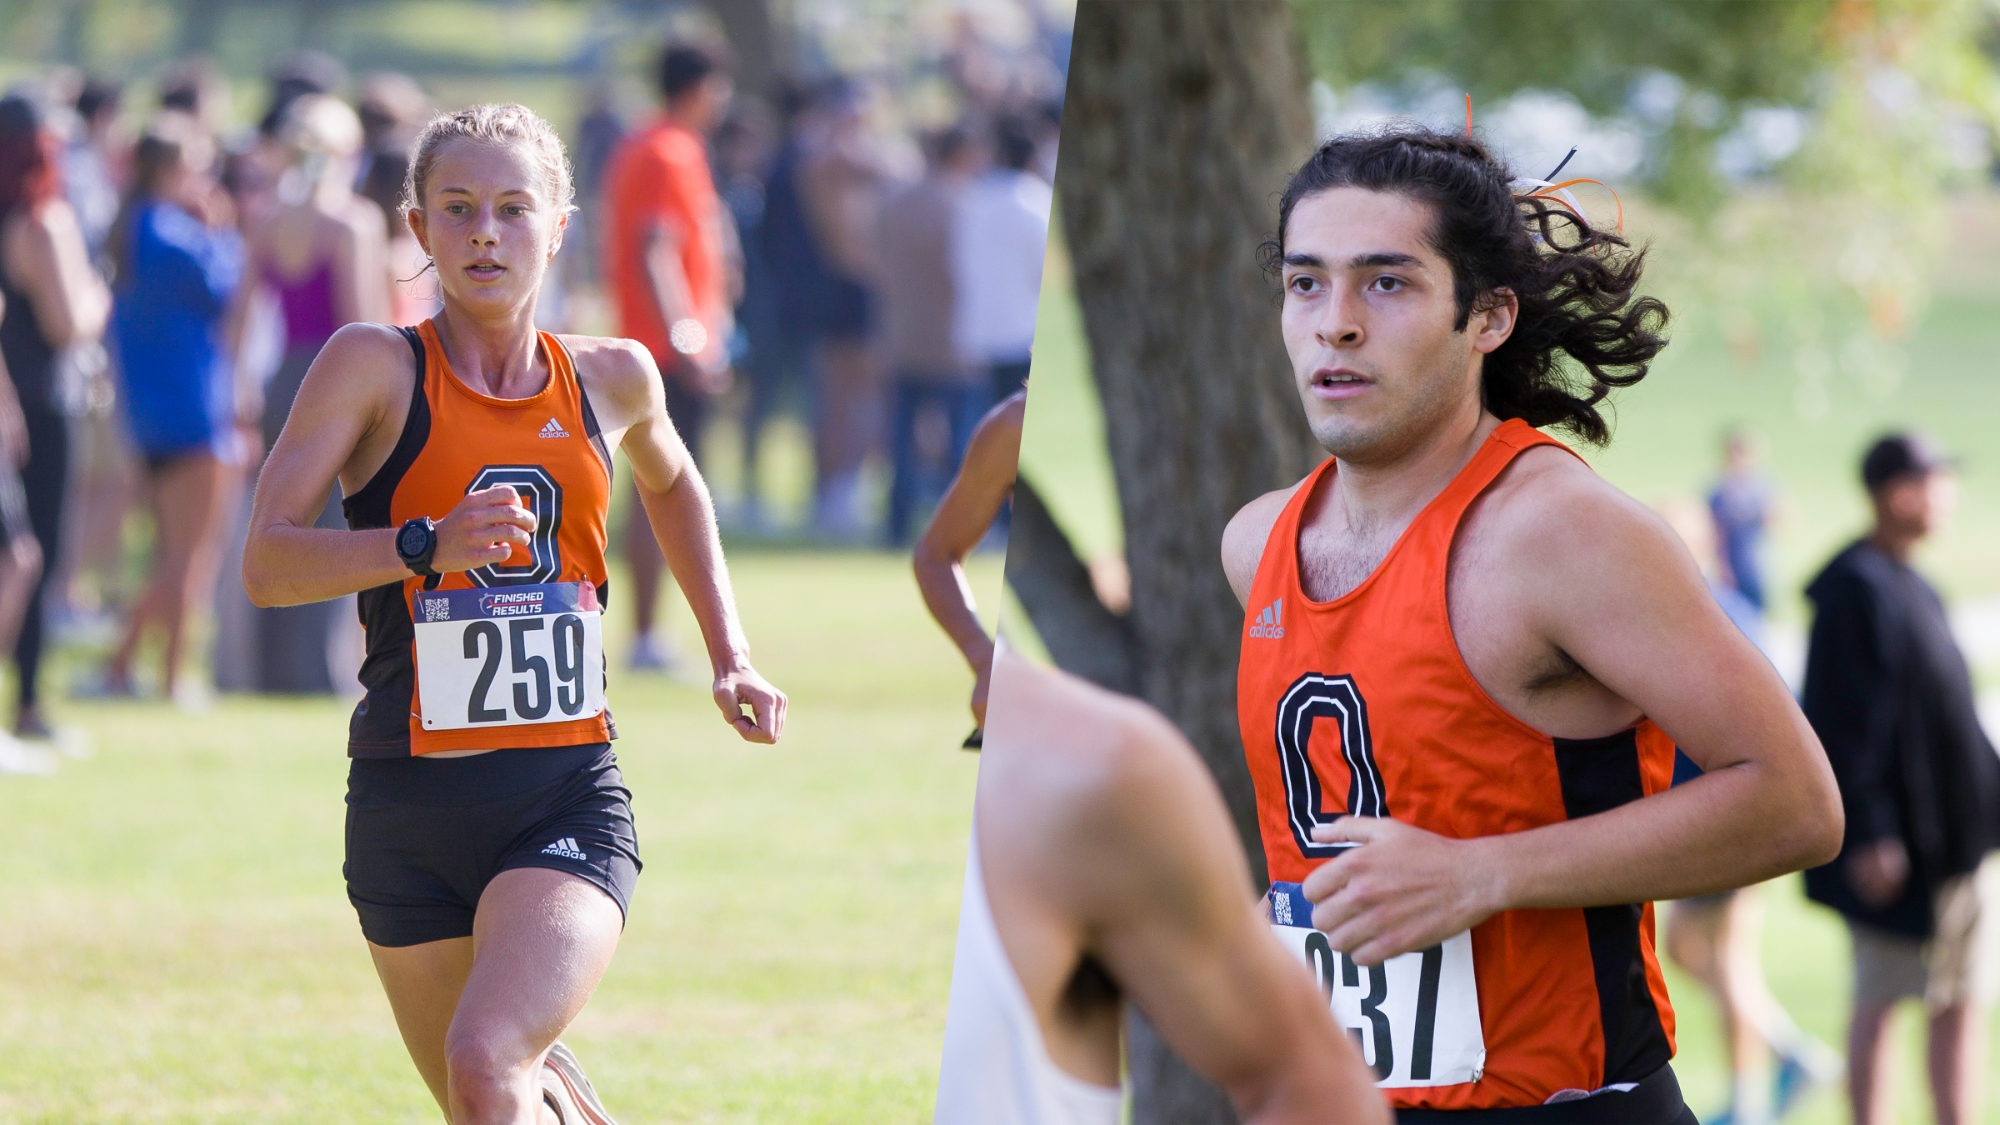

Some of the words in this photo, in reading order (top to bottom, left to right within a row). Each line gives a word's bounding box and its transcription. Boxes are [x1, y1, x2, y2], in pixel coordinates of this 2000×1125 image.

[538, 430, 570, 439] adidas
[494, 592, 544, 604] FINISHED
[492, 604, 542, 616] RESULTS
[1249, 622, 1285, 640] adidas
[463, 613, 585, 724] 259
[541, 848, 587, 861] adidas
